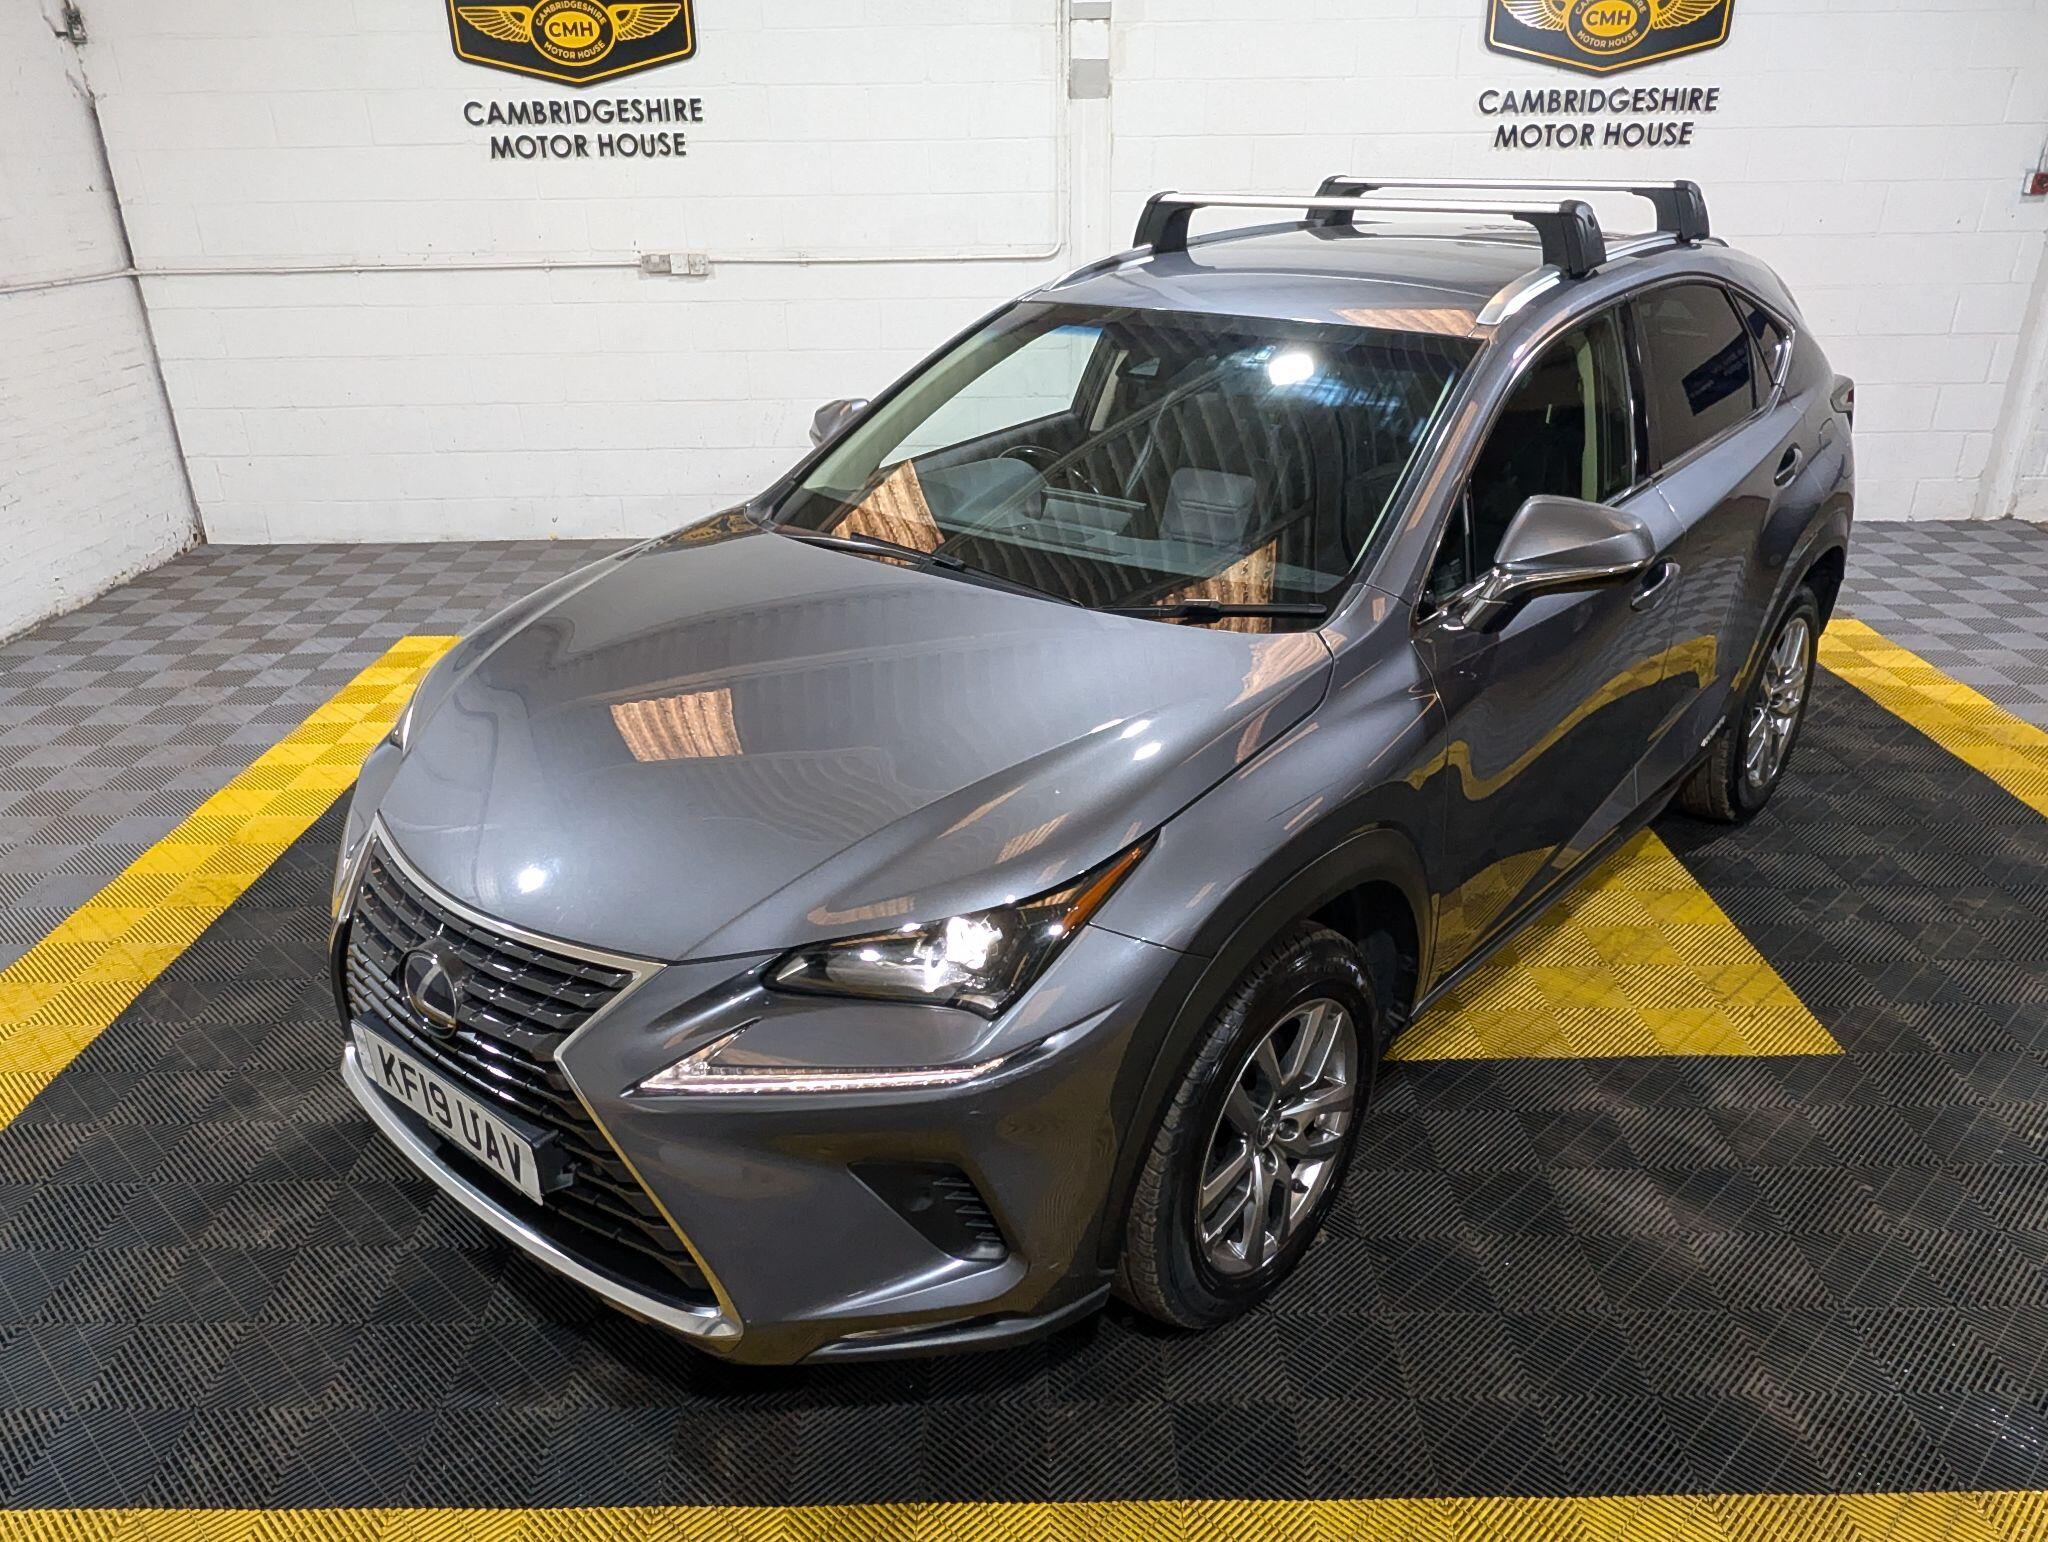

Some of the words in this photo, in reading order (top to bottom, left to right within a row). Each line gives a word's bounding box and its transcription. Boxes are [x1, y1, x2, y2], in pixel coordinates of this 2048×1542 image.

[536, 1, 607, 26] CAMBRIDGESHIRE
[1586, 10, 1631, 26] CMH
[549, 22, 593, 37] CMH
[1577, 30, 1606, 48] MOTOR
[1608, 29, 1639, 48] HOUSE
[544, 41, 576, 59] MOTOR
[577, 40, 606, 59] HOUSE
[464, 98, 704, 126] CAMBRIDGESHIRE
[1479, 87, 1720, 115] CAMBRIDGESHIRE
[491, 134, 589, 159] MOTOR
[597, 132, 687, 158] HOUSE
[1494, 123, 1595, 148] MOTOR
[1603, 122, 1694, 147] HOUSE
[377, 1044, 453, 1130] KF19
[456, 1099, 522, 1184] UAV
